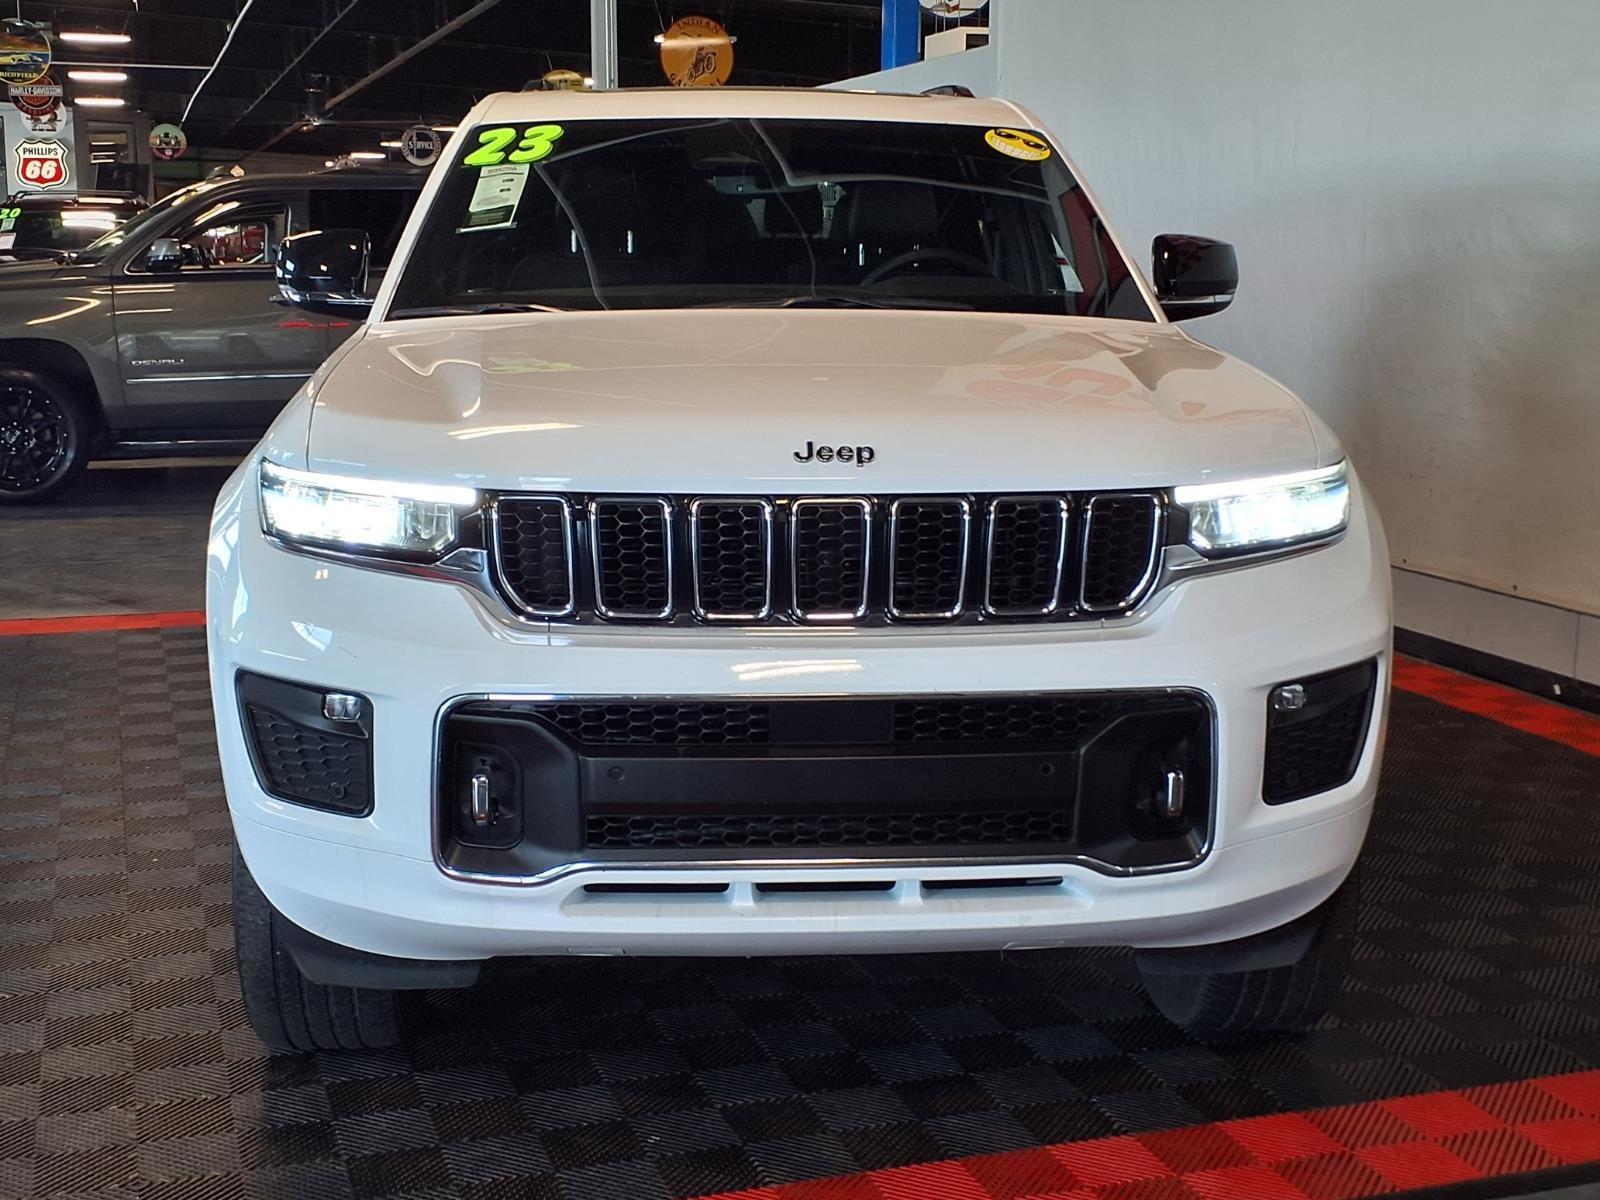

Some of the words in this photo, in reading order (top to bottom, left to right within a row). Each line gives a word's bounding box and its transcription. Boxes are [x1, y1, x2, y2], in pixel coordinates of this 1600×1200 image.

[22, 147, 59, 156] PHILLIPS
[463, 124, 564, 167] 23
[25, 160, 58, 180] 66
[131, 358, 184, 366] DENALI
[793, 440, 875, 467] Jeep
